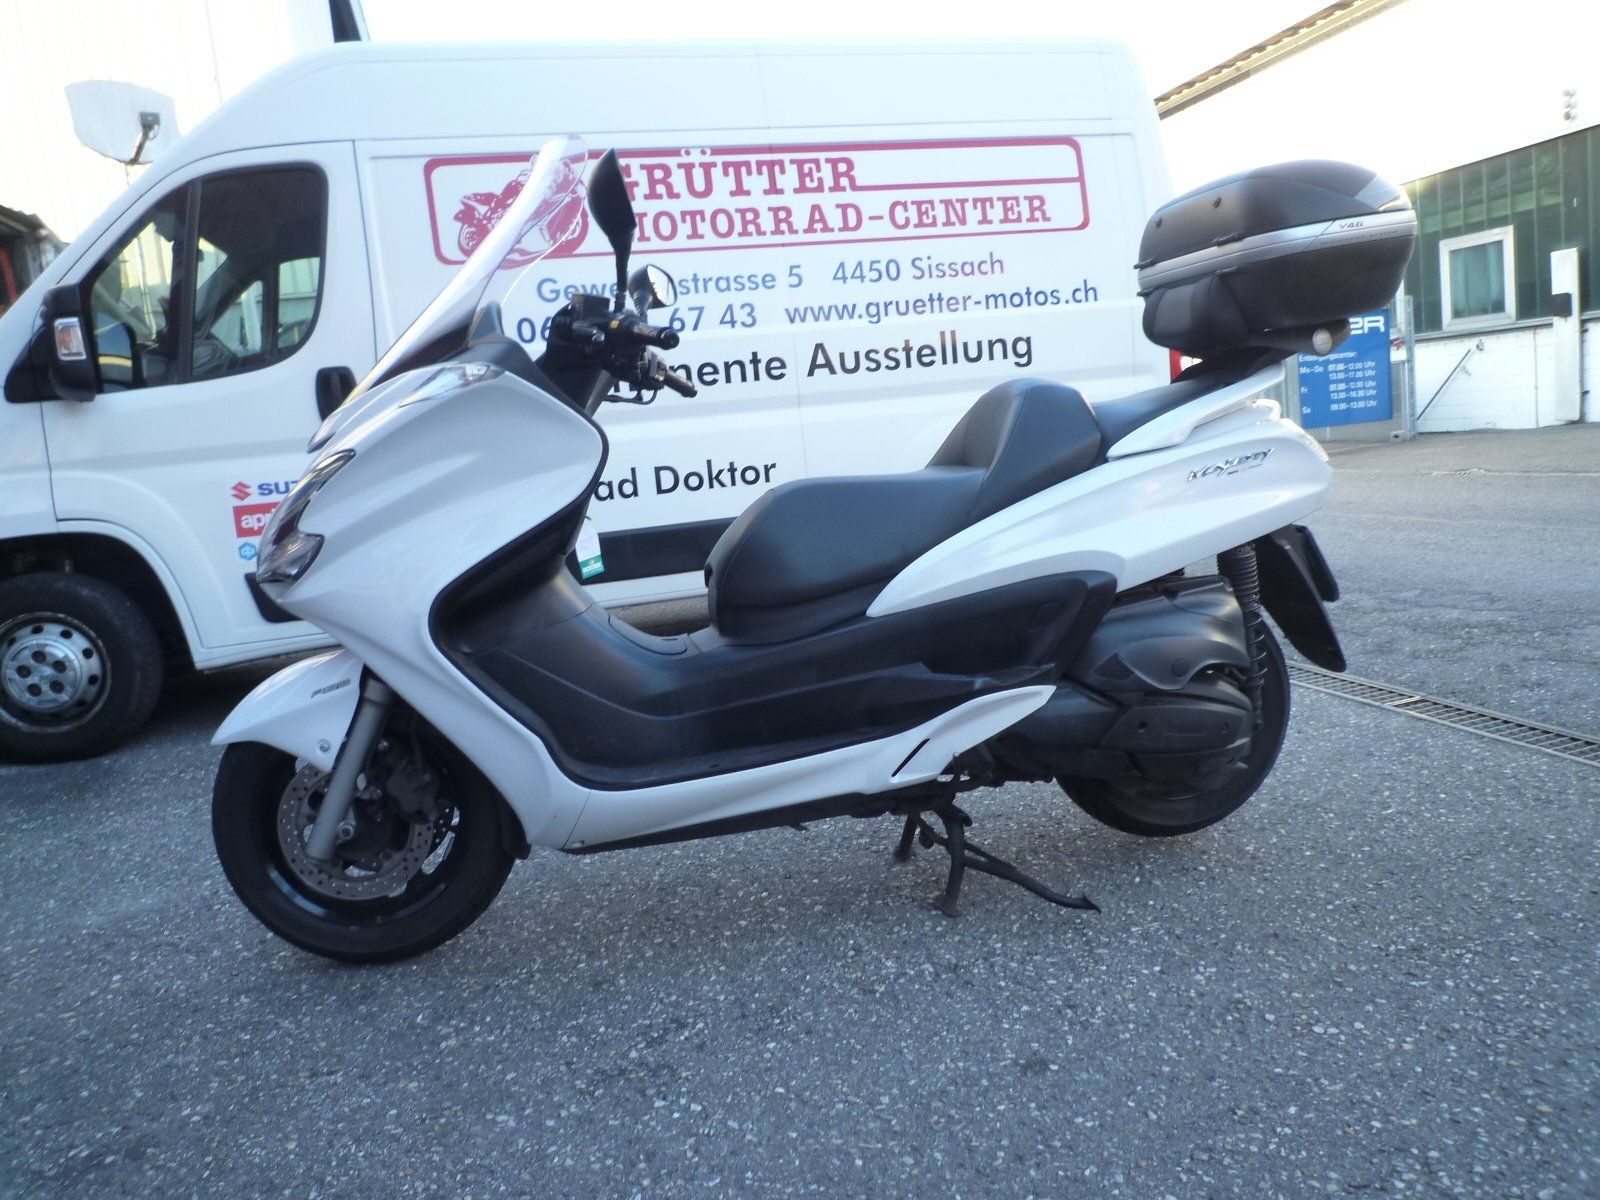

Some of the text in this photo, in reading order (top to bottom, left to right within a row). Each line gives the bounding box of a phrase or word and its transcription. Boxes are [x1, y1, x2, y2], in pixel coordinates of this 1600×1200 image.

[788, 264, 804, 288] 5
[832, 258, 901, 285] 4450
[911, 251, 1005, 279] Sissach
[668, 306, 705, 333] 67
[719, 302, 757, 329] 43
[784, 279, 1099, 325] www.gruetter-motos.ch
[806, 330, 1033, 377] Ausstellung
[654, 459, 777, 495] Doktor
